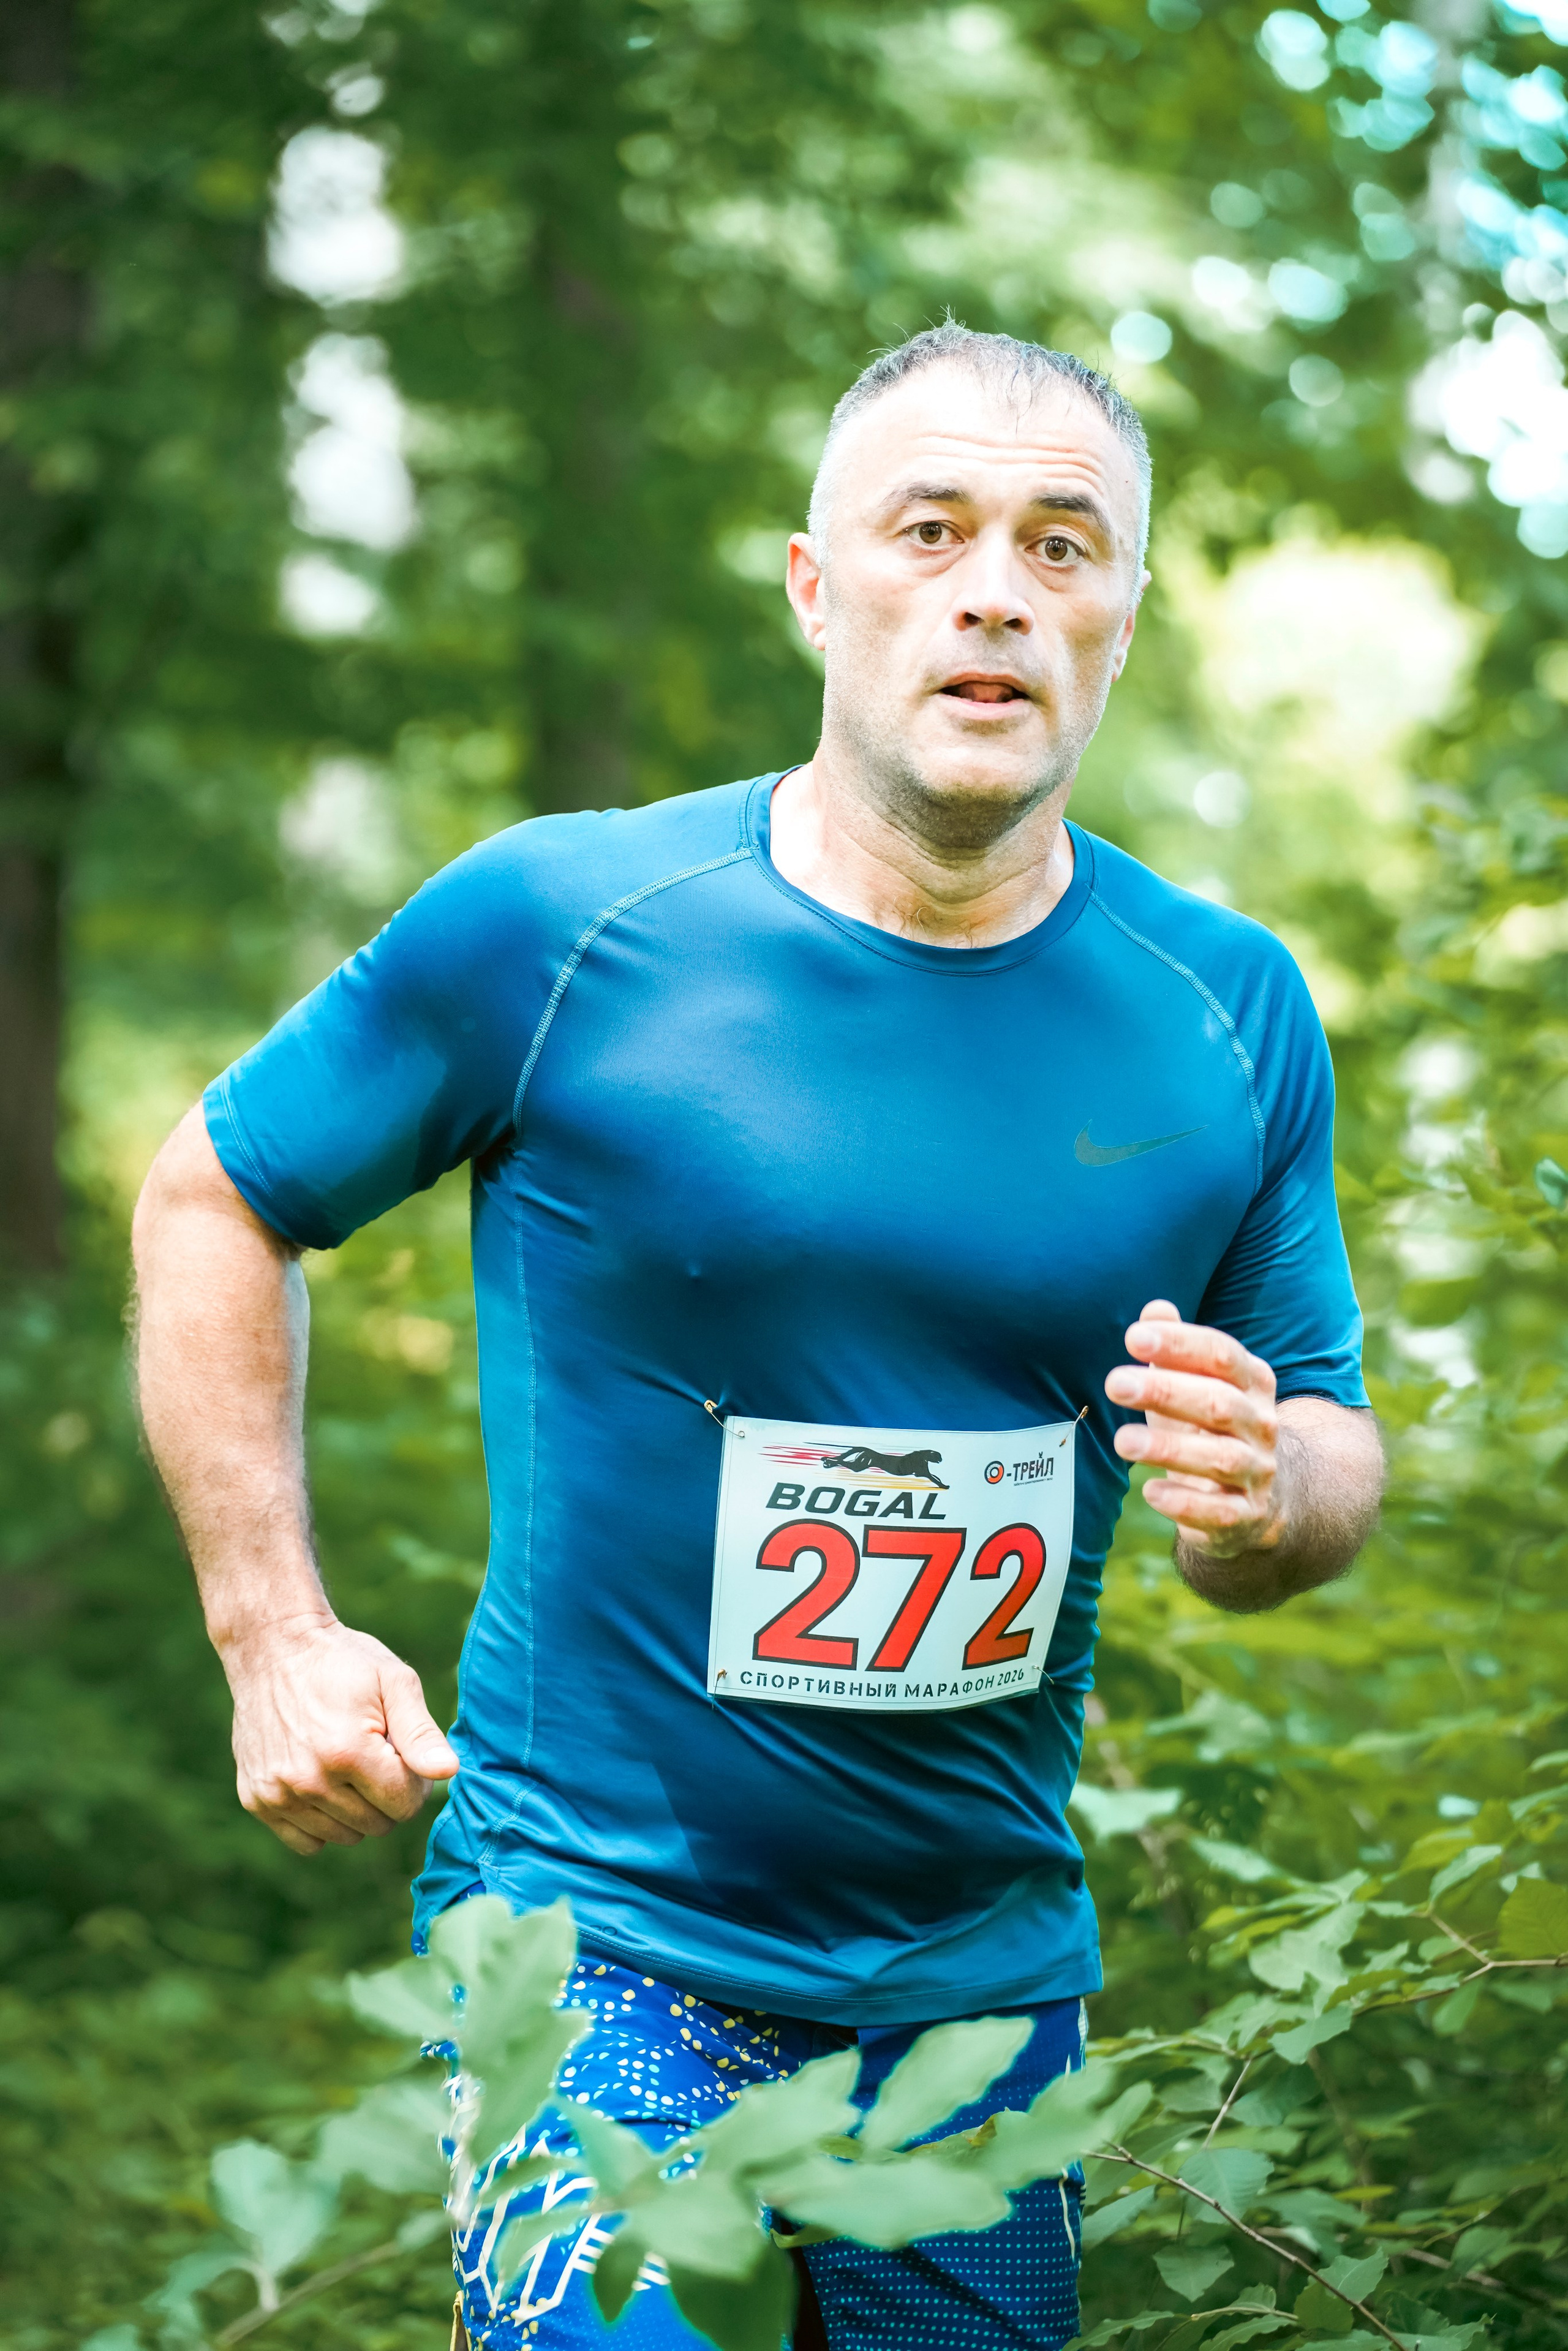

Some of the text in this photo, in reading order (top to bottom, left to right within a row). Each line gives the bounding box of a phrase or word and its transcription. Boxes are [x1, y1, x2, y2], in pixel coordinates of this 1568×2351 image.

[766, 1482, 947, 1520] BOGAL
[752, 1518, 1047, 1673] 272
[740, 1668, 1024, 1697] СПОРТИВНЫЙ МАРАФОН 2026
